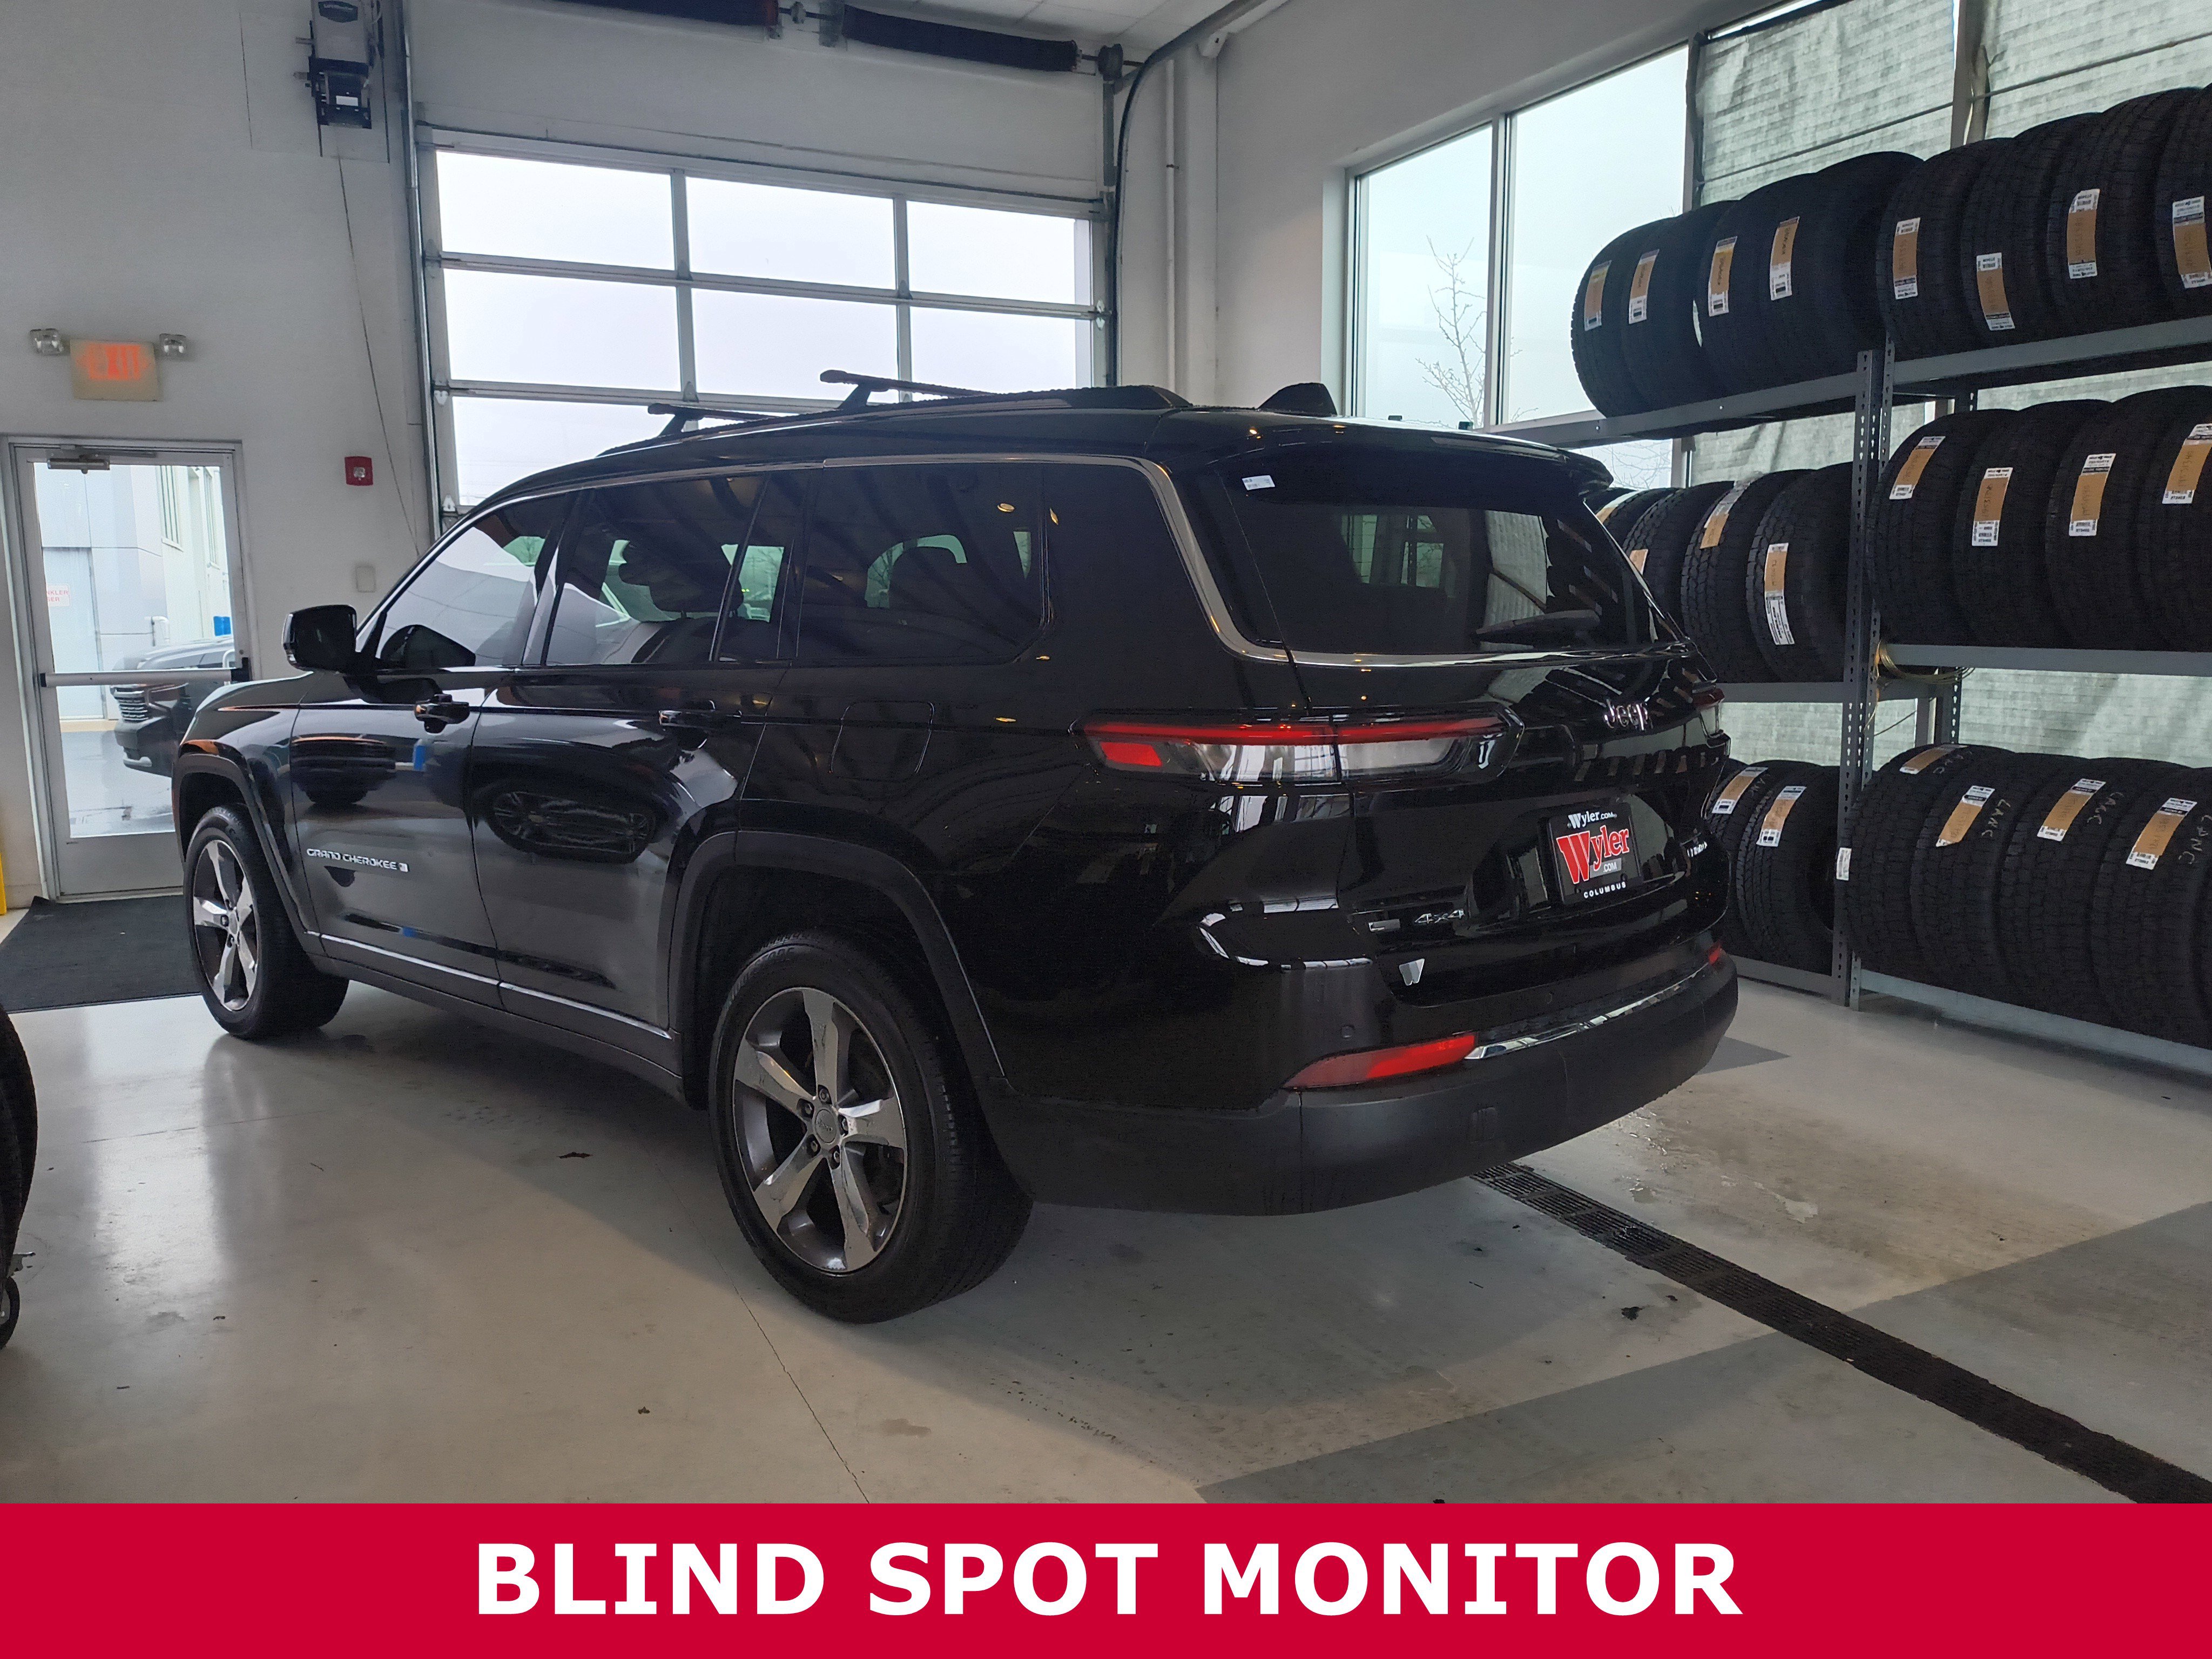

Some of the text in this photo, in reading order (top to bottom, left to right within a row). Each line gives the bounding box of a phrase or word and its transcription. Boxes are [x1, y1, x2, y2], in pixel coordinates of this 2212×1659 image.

[1603, 699, 1649, 731] Jeep
[306, 848, 341, 860] GRAND
[342, 853, 397, 870] CHEROKEE
[1556, 825, 1630, 885] Wyler
[1583, 881, 1627, 899] COLUMBUS
